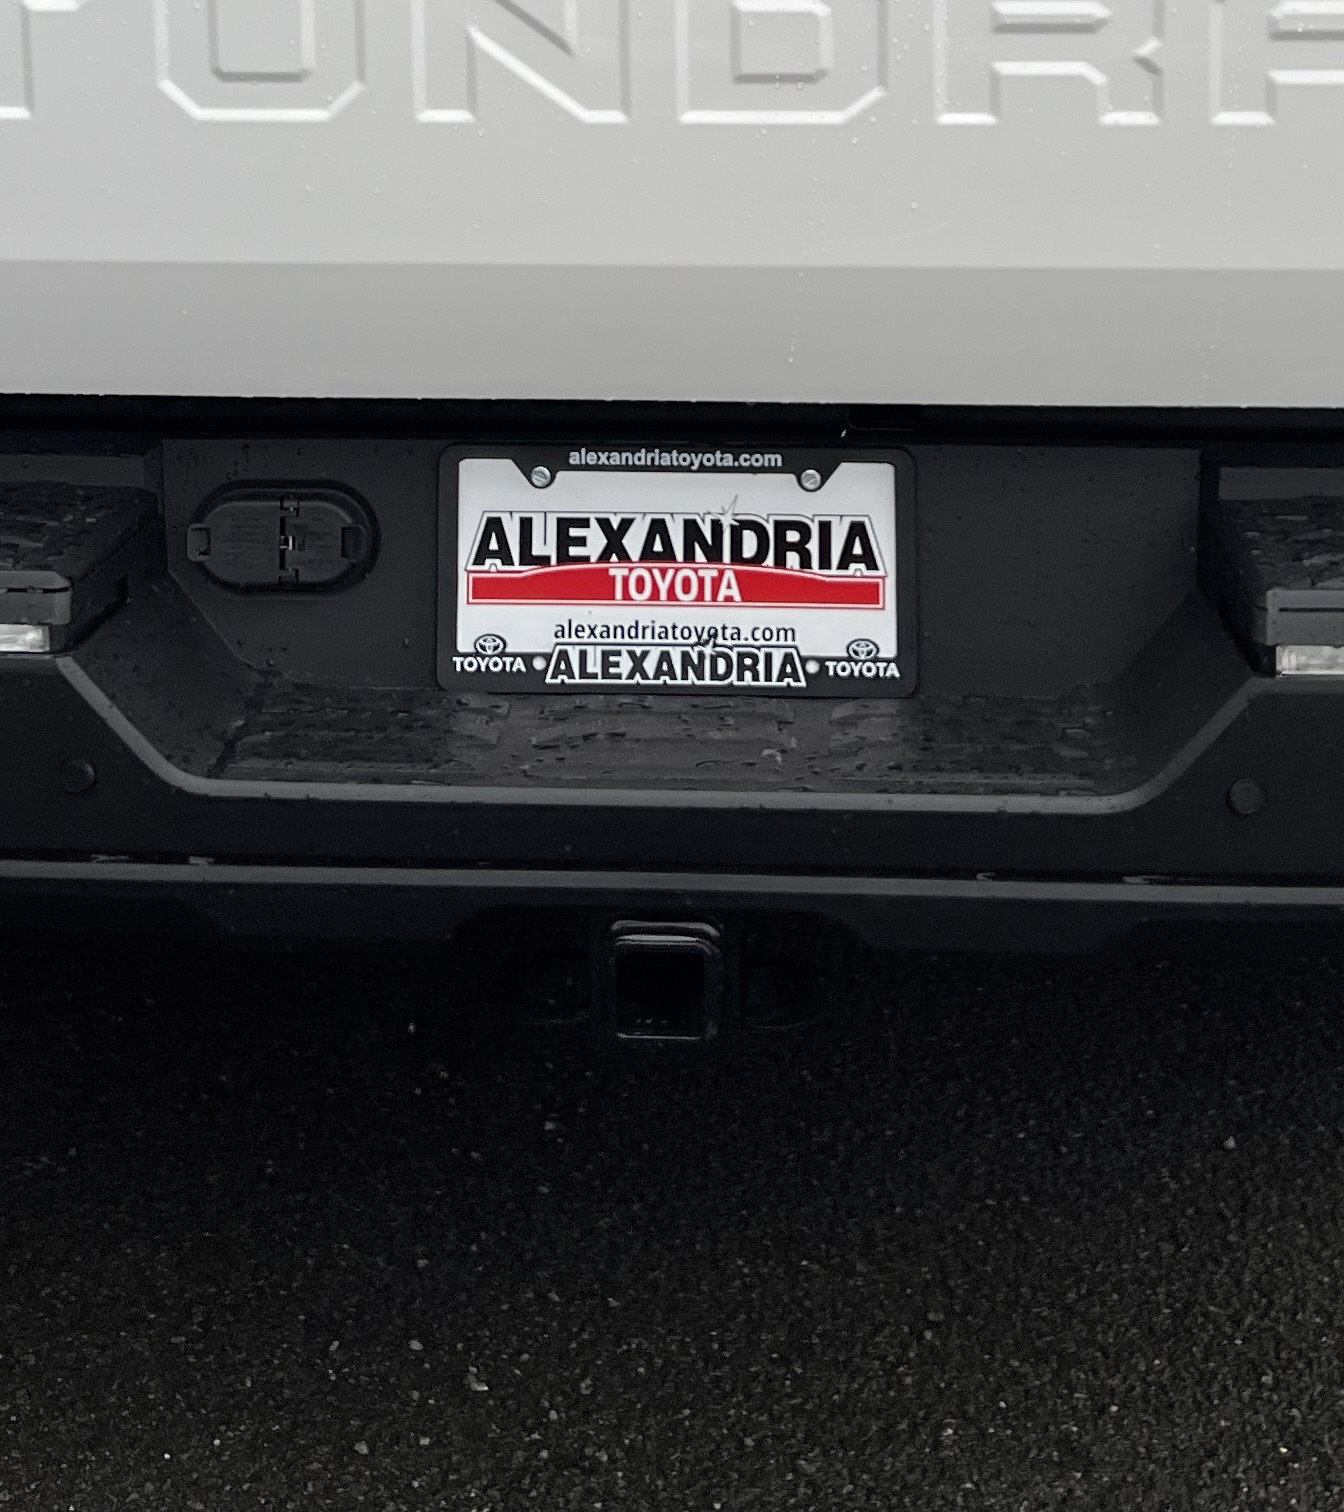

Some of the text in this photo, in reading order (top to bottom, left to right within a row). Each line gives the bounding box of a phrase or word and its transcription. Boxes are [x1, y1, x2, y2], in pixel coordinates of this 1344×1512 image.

[567, 447, 784, 471] alexandriatoyota.com
[471, 514, 881, 572] ALEXANDRIA
[608, 567, 742, 602] TOYOTA
[553, 619, 797, 644] alexandriatoyota.com
[453, 656, 527, 673] TOYOTA
[548, 647, 804, 686] ALEXANDRIA
[825, 659, 901, 678] TOYOTA
